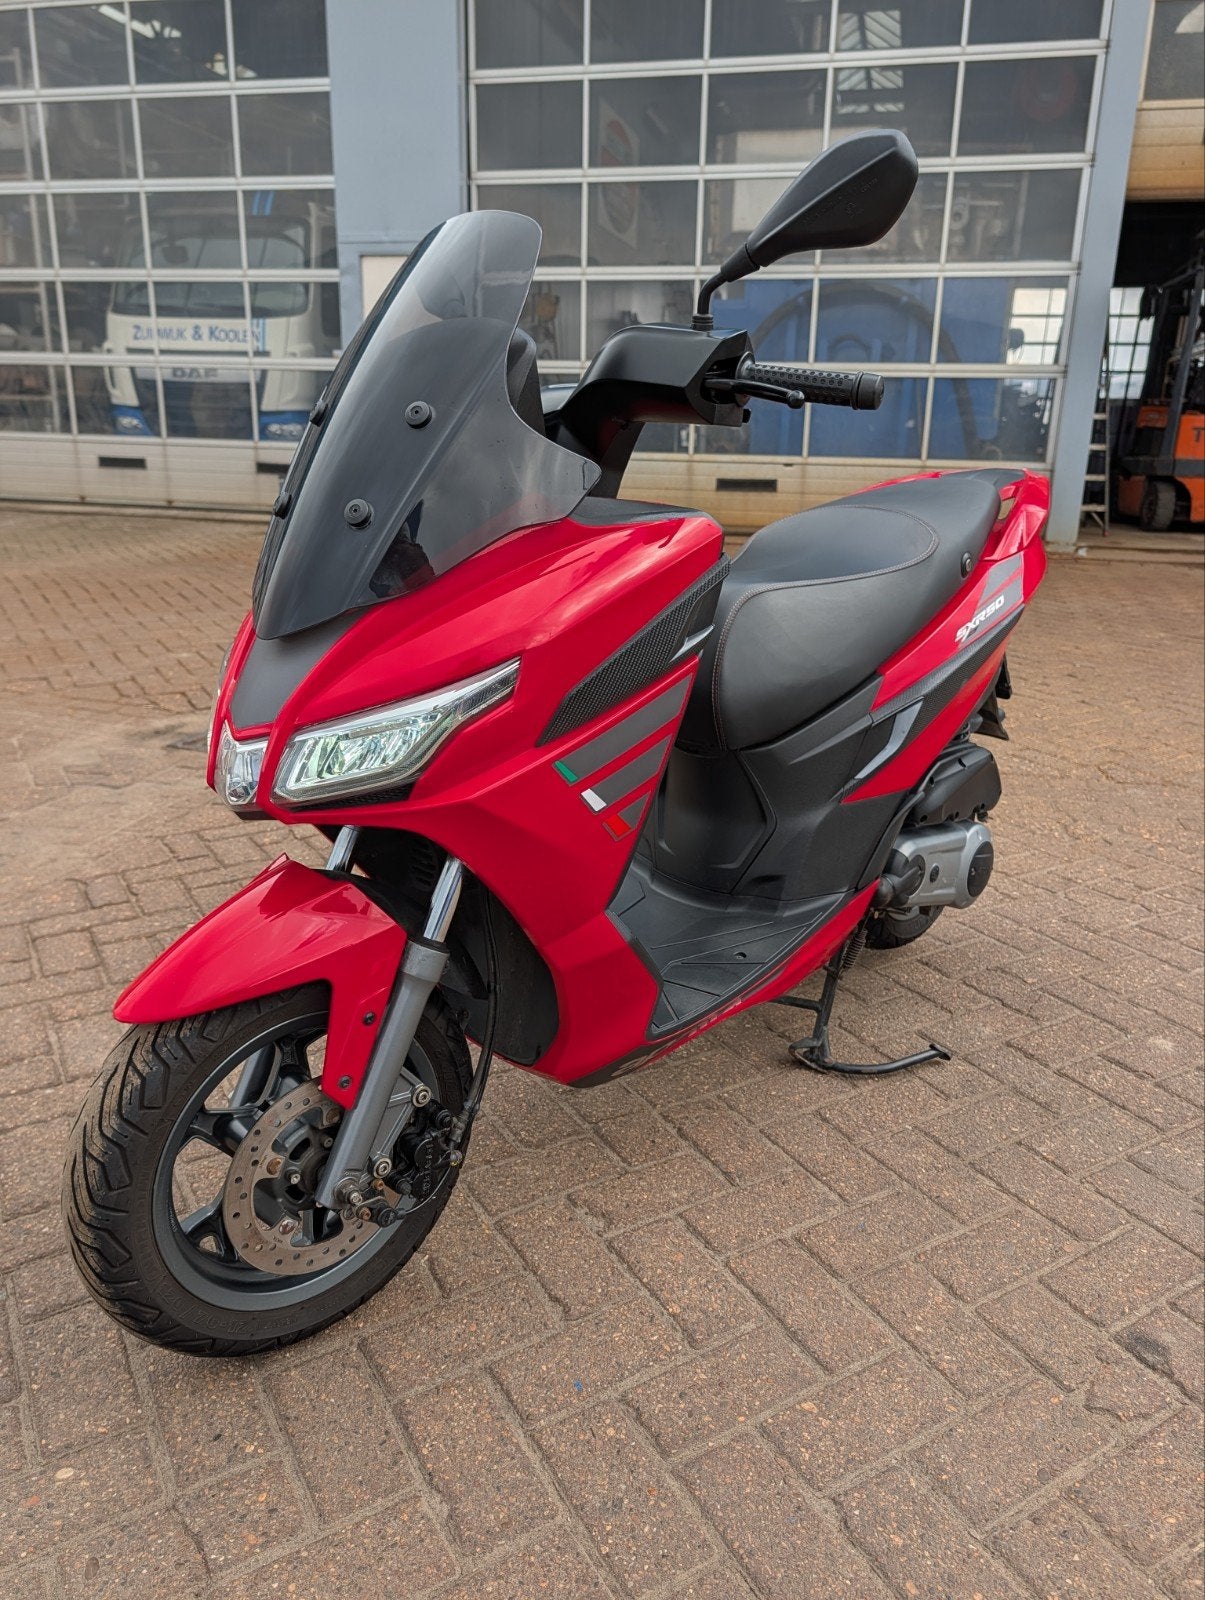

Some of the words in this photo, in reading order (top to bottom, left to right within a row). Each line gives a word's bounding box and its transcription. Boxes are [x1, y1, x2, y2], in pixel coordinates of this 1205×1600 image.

[132, 324, 187, 340] ZUIWIJK
[191, 324, 205, 341] &
[172, 367, 219, 379] DAF
[954, 594, 1005, 643] SXR50
